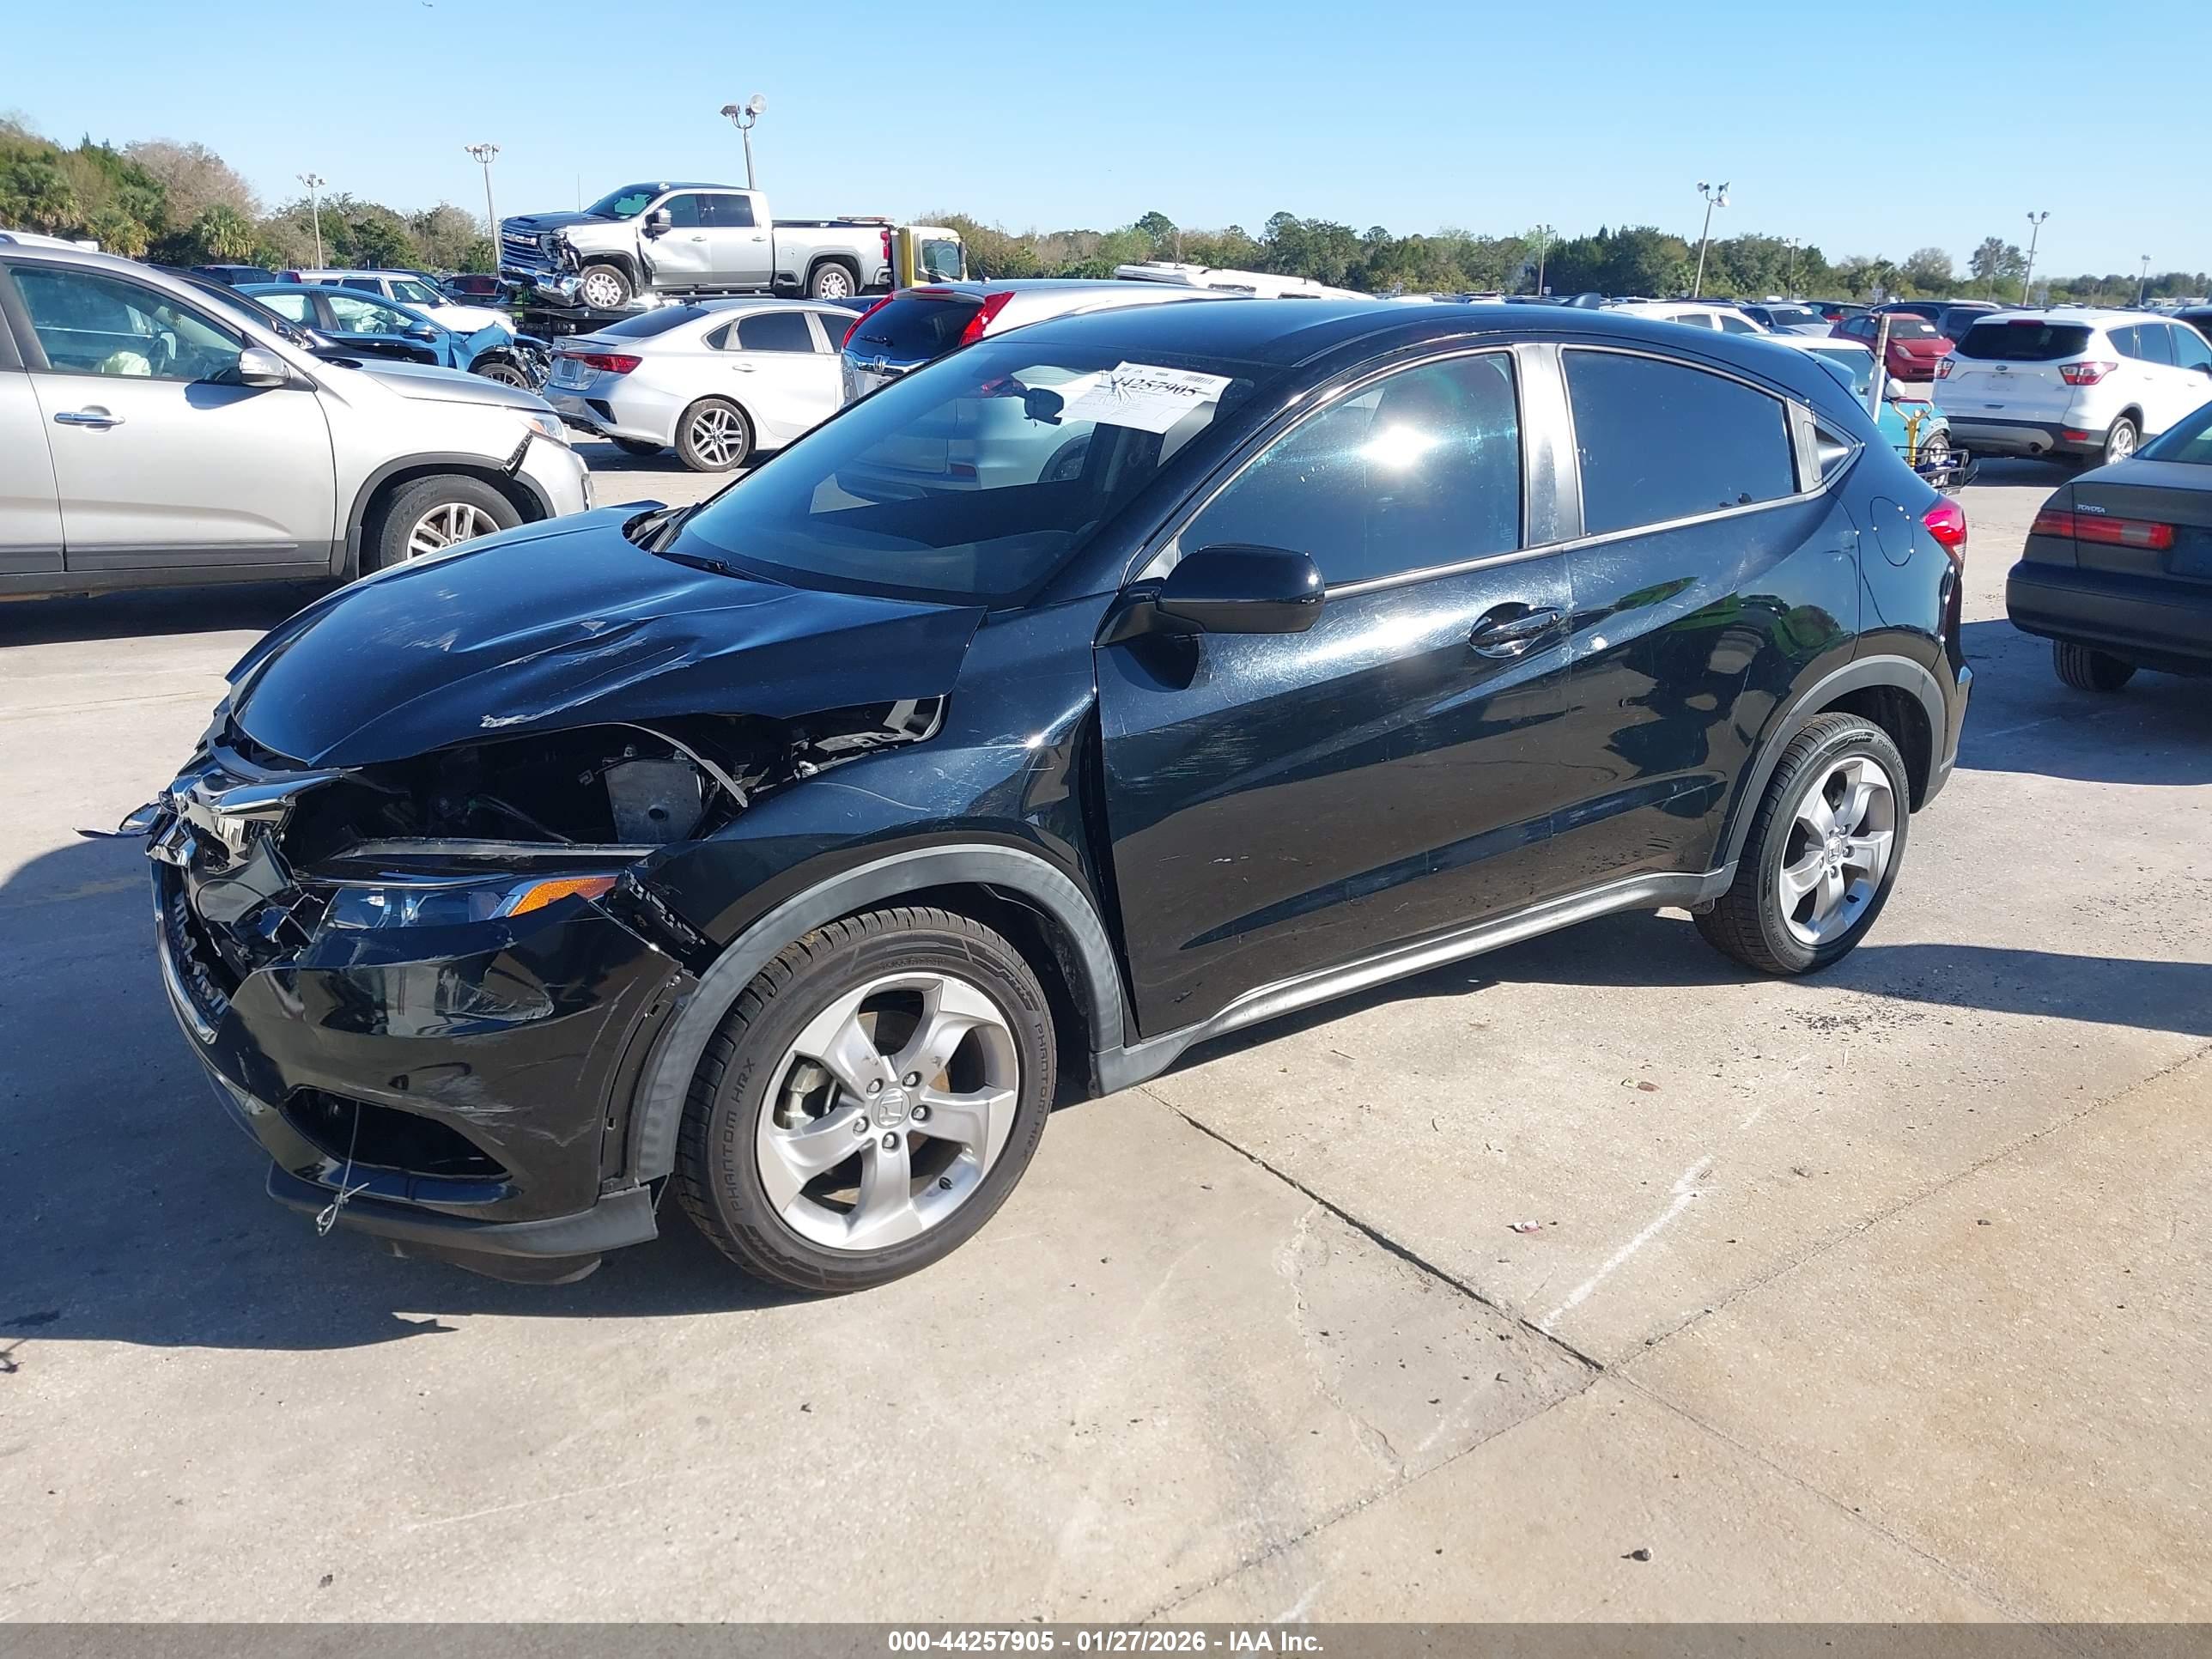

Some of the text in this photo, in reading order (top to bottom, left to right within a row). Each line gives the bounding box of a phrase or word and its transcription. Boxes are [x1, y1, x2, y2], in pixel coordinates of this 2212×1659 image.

[2077, 504, 2106, 514] TOYOTA
[1035, 1024, 1048, 1115] PHANTOM
[723, 1057, 757, 1212] PHANTOM HRX
